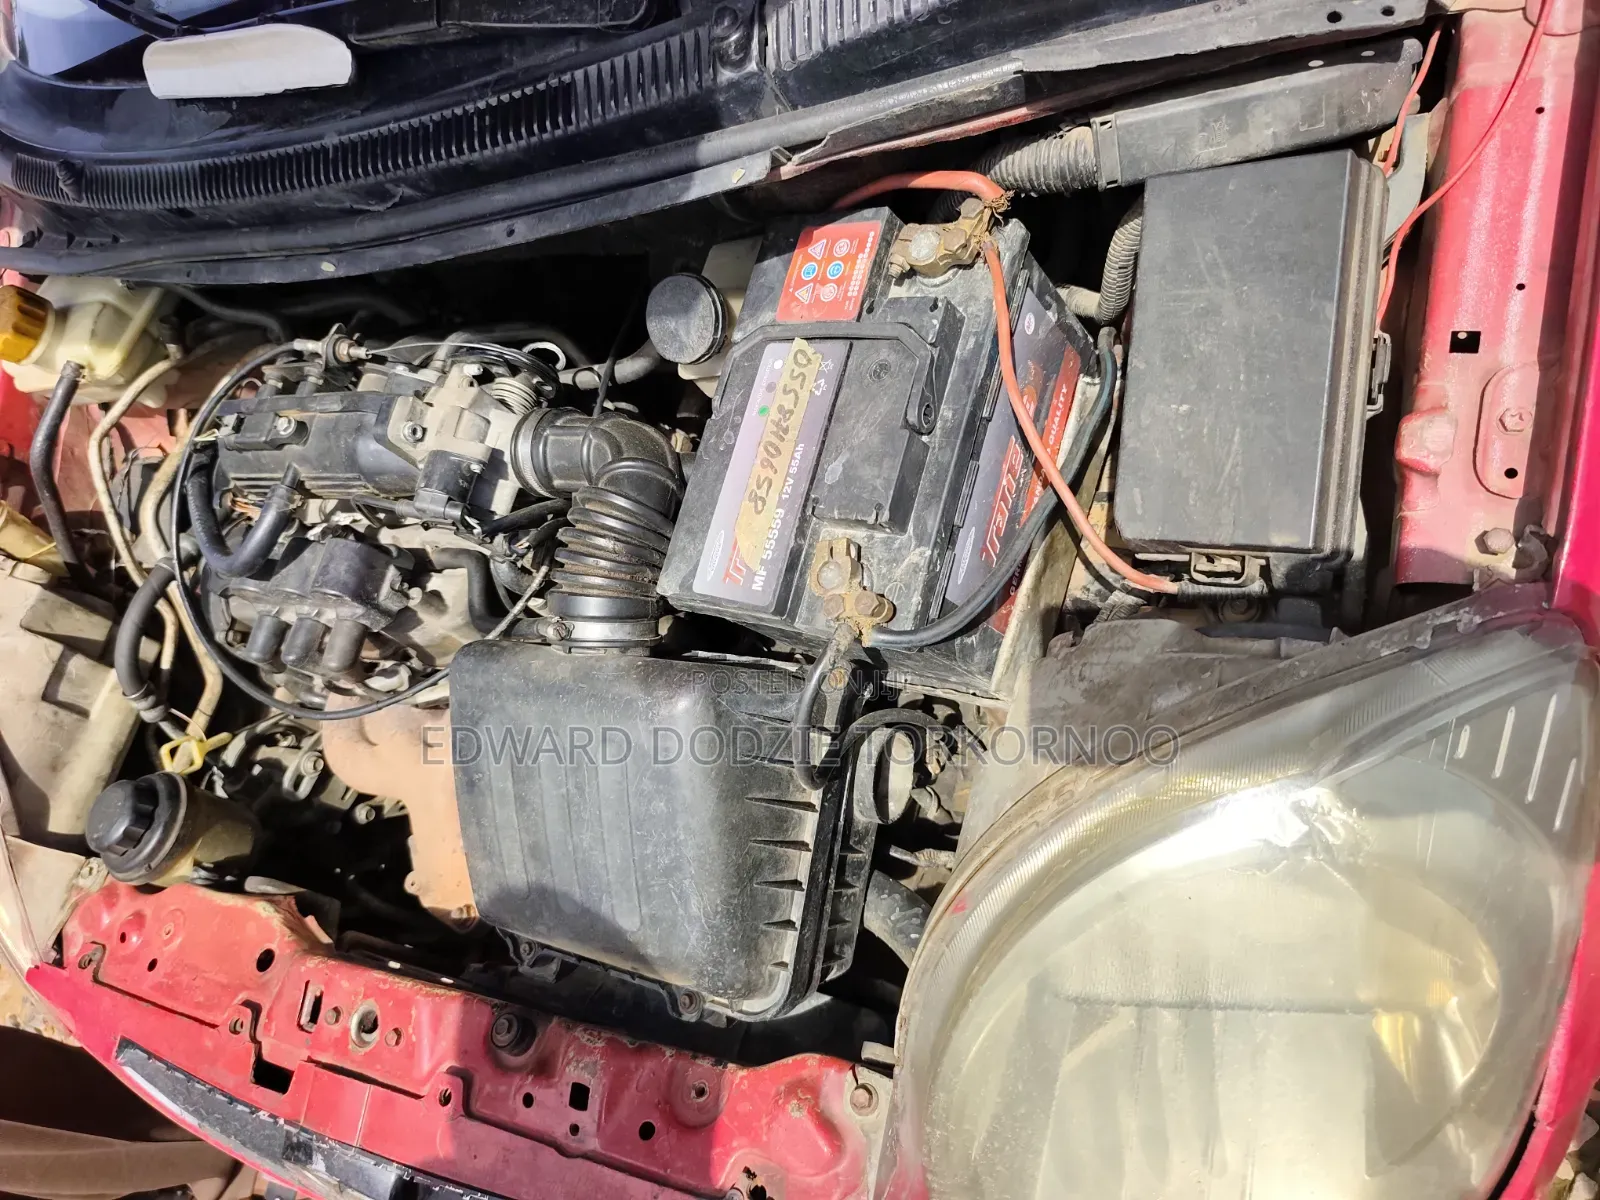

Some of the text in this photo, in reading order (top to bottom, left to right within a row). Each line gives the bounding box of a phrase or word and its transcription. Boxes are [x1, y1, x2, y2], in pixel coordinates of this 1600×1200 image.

[1048, 383, 1069, 446] QUALITY
[751, 443, 805, 592] MF 55559 12V 55Ah
